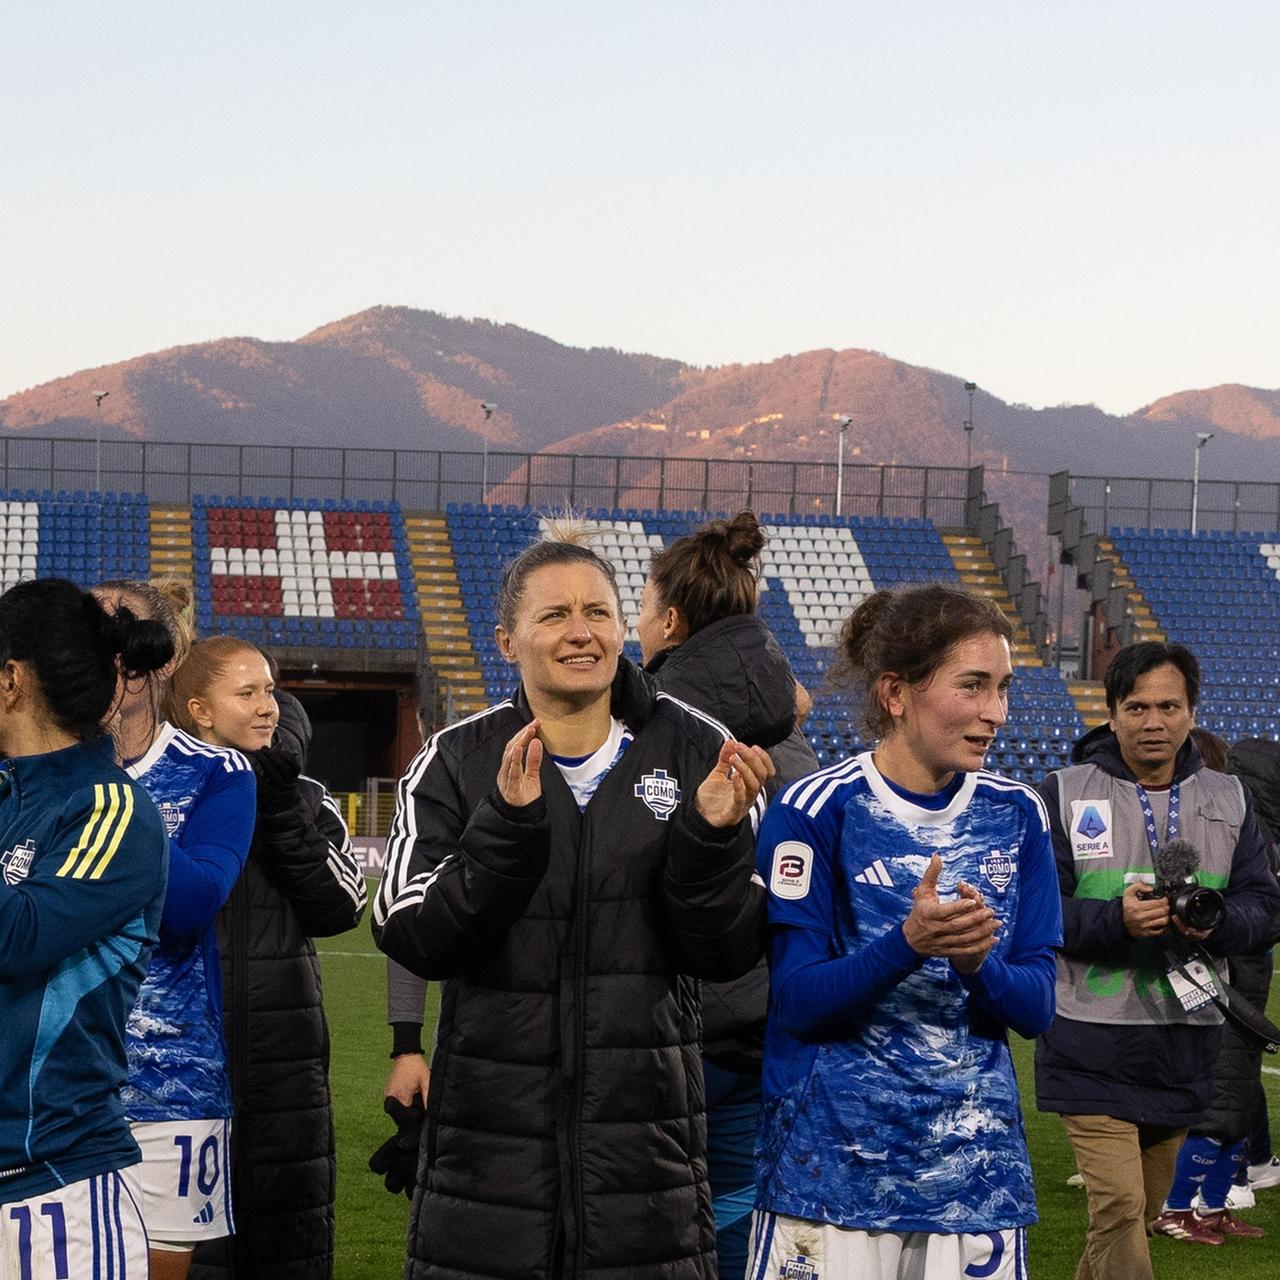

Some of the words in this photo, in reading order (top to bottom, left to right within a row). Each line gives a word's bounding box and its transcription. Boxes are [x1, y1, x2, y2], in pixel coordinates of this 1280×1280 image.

[646, 785, 674, 799] COMO
[1076, 842, 1101, 851] SERIE
[1102, 841, 1109, 849] A
[987, 862, 1010, 874] COMO
[174, 1135, 220, 1197] 10
